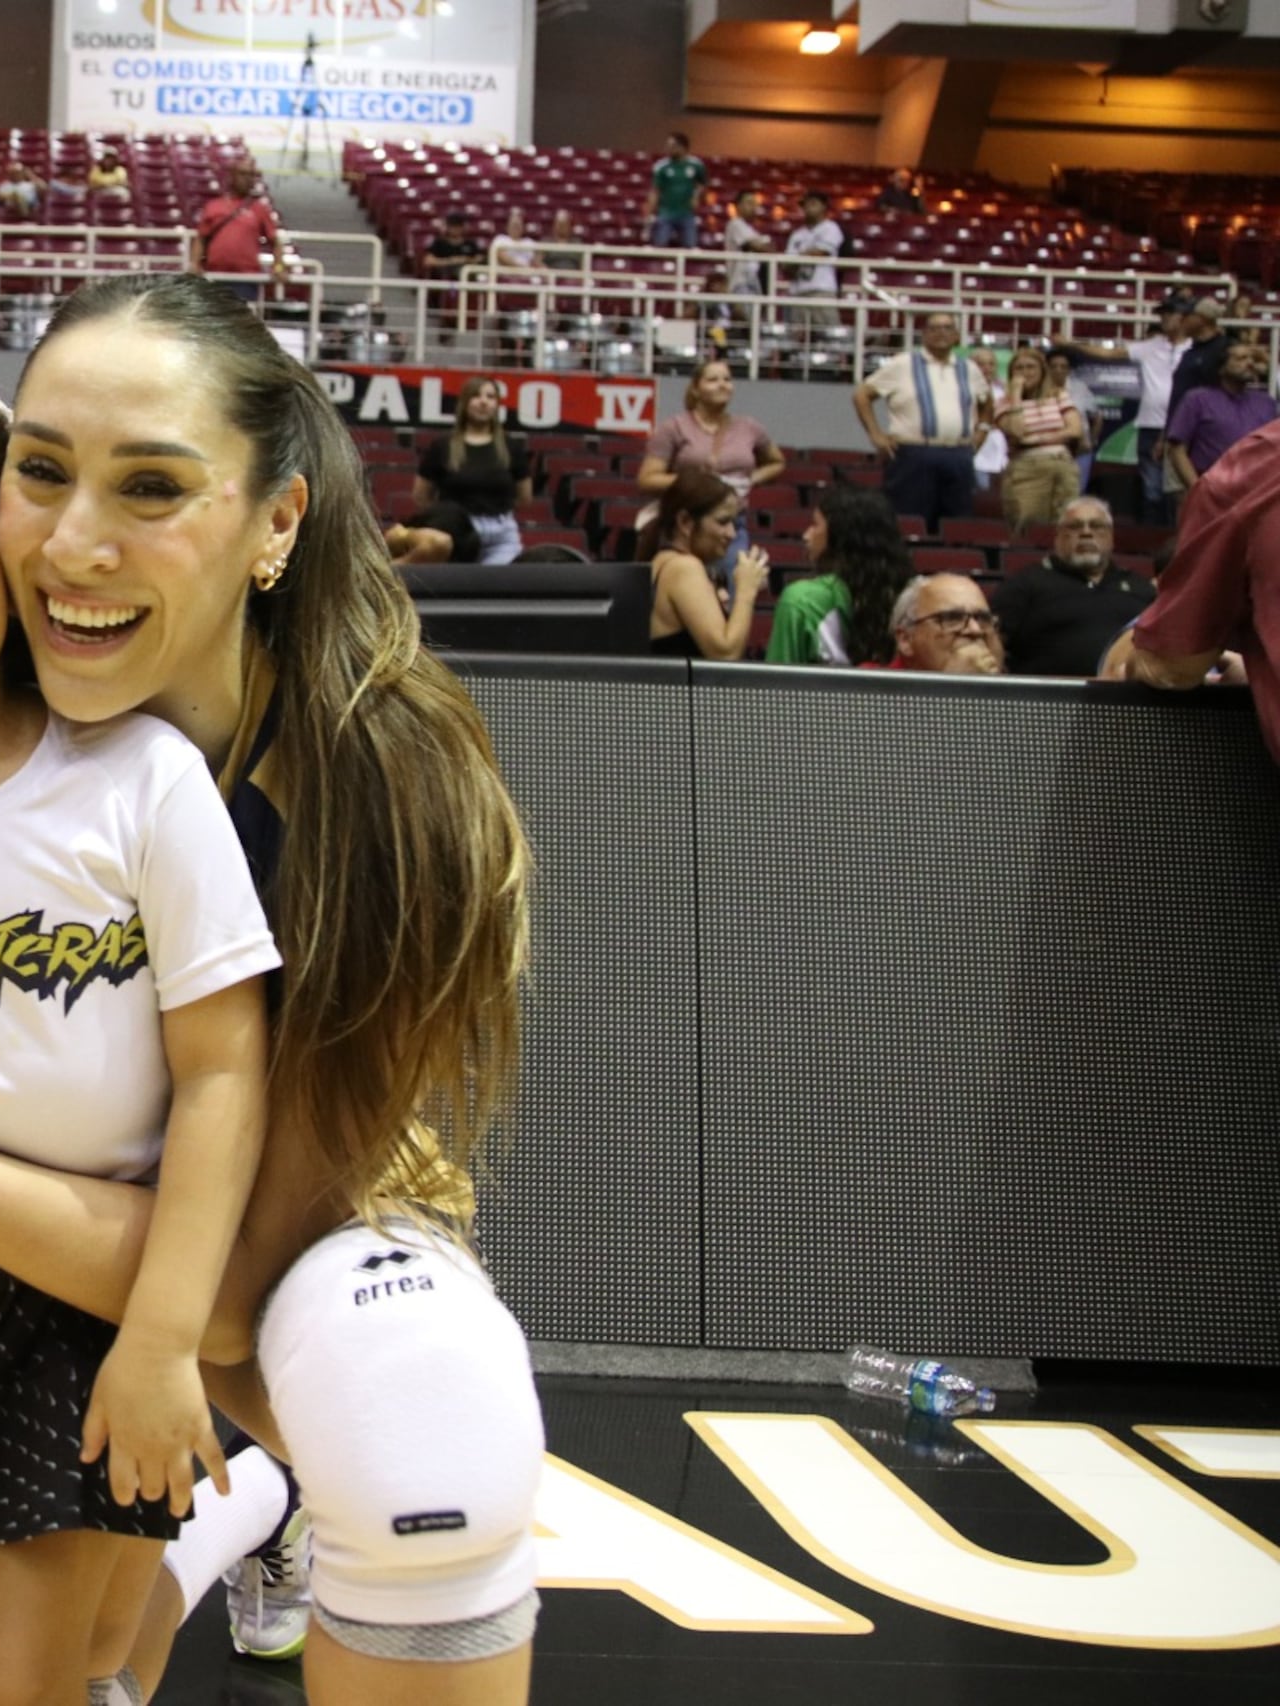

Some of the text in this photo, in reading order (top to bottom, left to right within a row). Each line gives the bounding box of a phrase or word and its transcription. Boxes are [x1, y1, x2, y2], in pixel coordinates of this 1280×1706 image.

[72, 32, 155, 49] SOMOS
[81, 58, 497, 91] EL COMBUSTIBLE QUE ENERGIZA
[110, 88, 468, 124] TU HOGAR Y NEGOCIO
[314, 371, 654, 432] PALO IV
